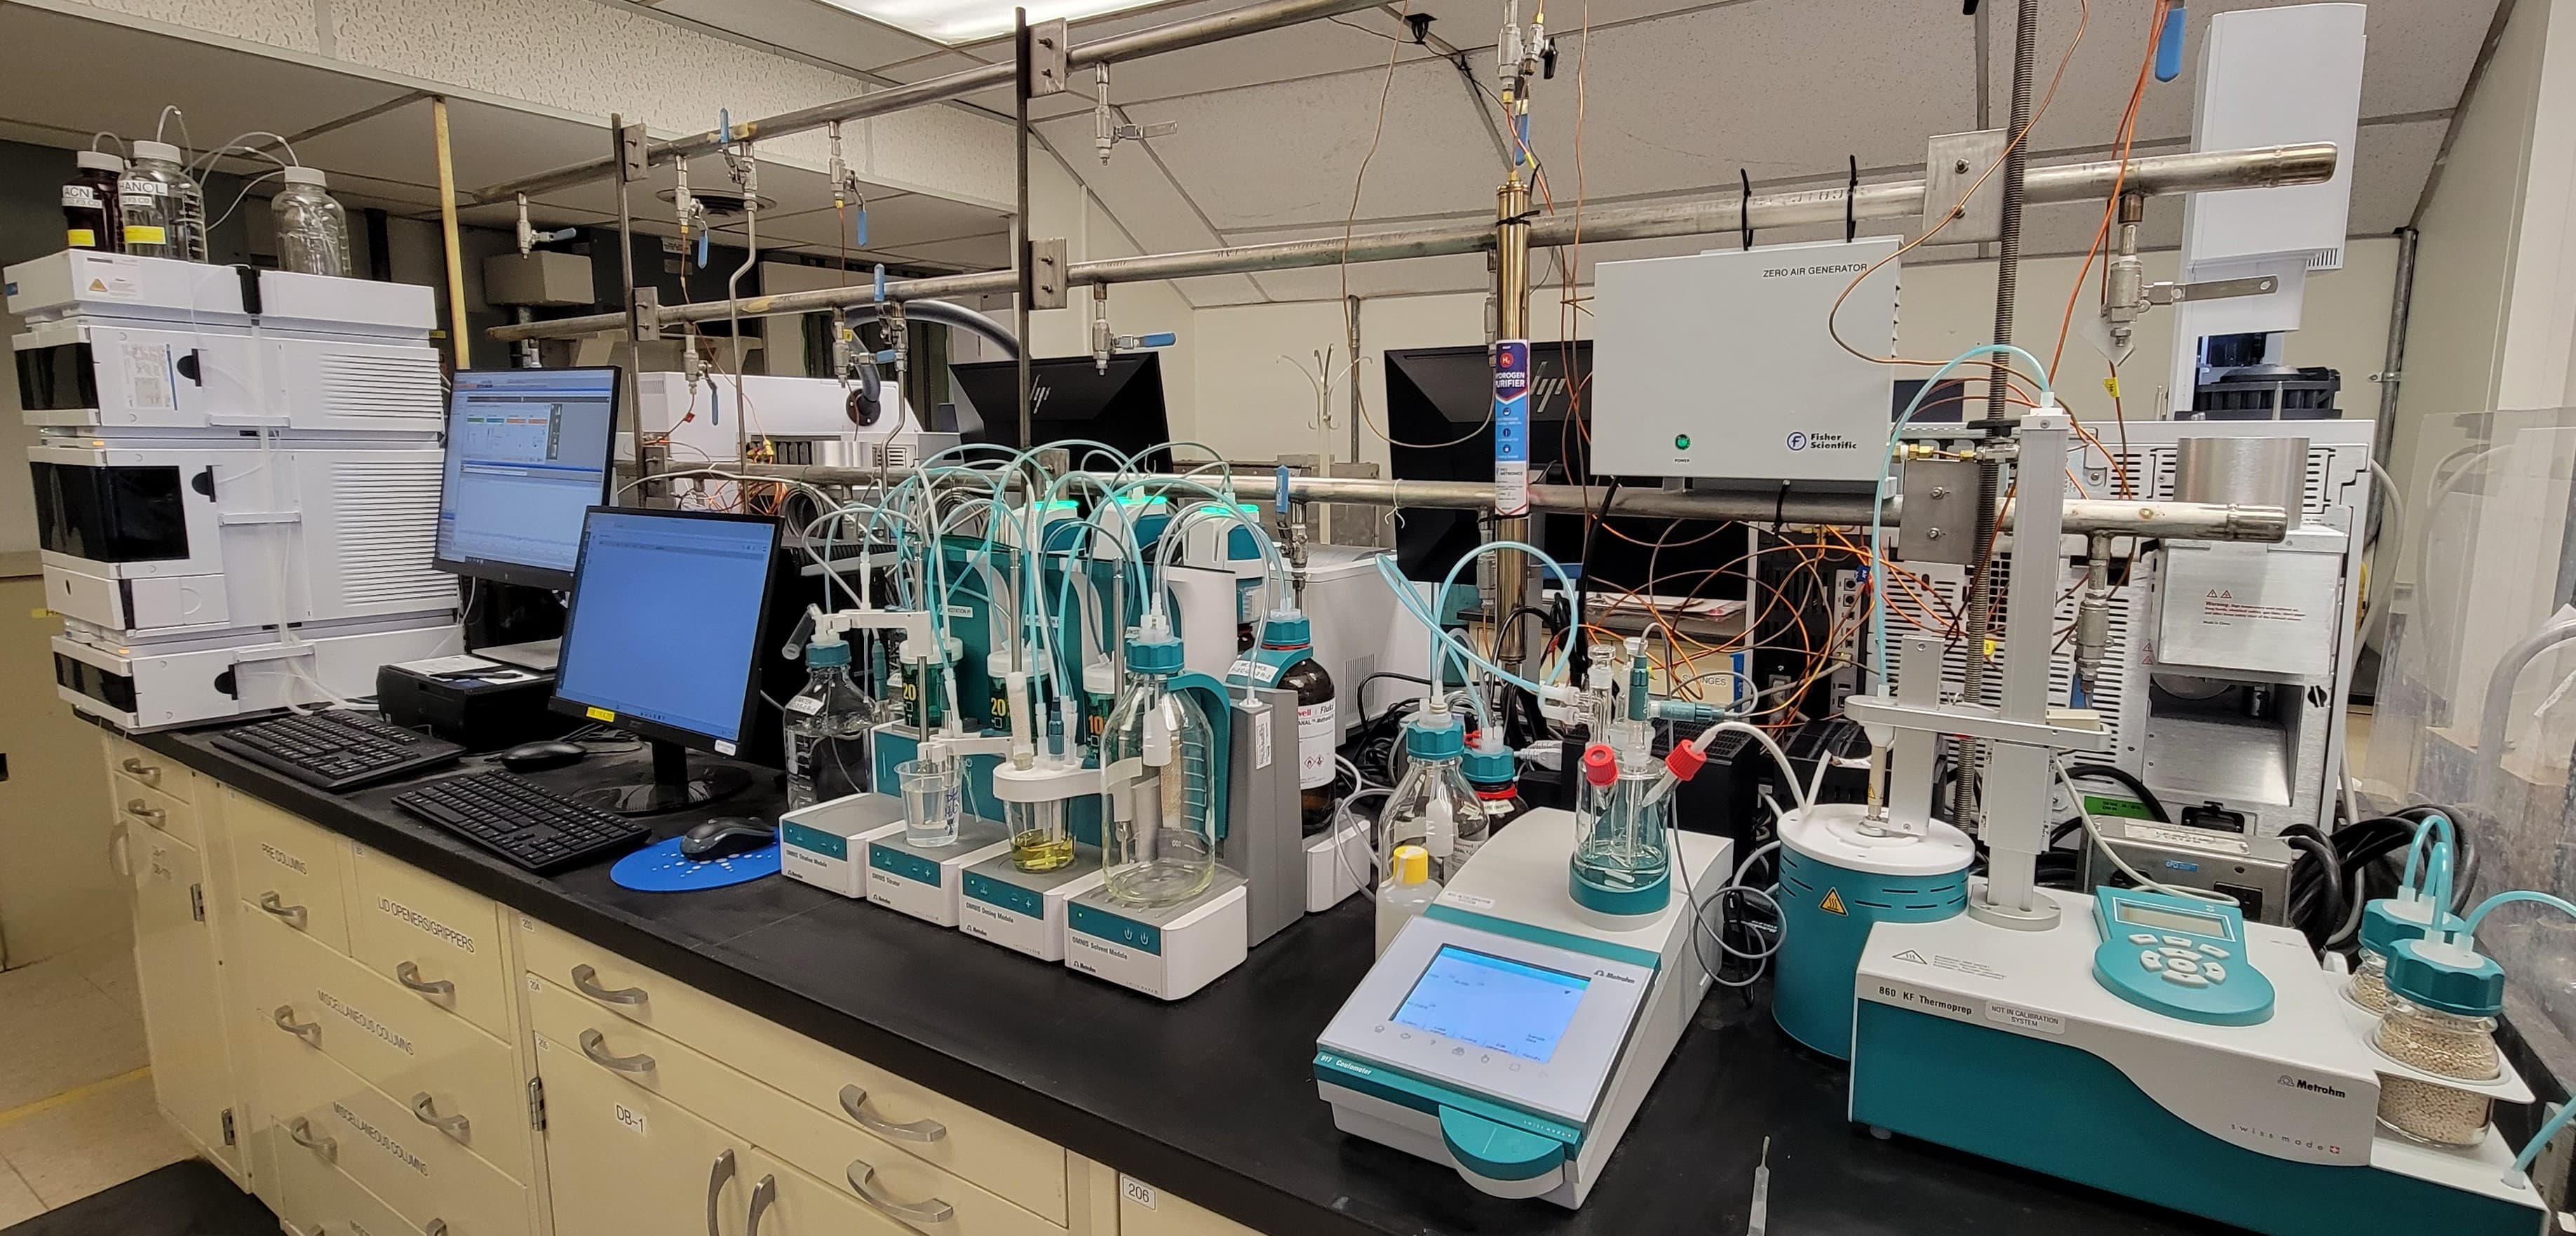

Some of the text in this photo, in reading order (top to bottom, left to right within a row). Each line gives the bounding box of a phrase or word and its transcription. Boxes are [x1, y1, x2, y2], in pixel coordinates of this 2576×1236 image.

[65, 187, 90, 199] ACN
[1763, 263, 1868, 278] ZERO AIR GENERATOR
[903, 683, 917, 701] 20
[991, 697, 1006, 716] 20
[1088, 715, 1104, 737] 10
[377, 895, 391, 913] LID
[1109, 948, 1128, 960] Module
[1879, 986, 1972, 1016] 860 KF Thermoprep
[1991, 1005, 2006, 1014] NOT
[2015, 1009, 2059, 1026] CALIBRATION
[2011, 1016, 2038, 1027] SYSTEM
[376, 1023, 414, 1056] COLUMNS
[1320, 1055, 1373, 1075] 917 Coulometer
[2296, 1079, 2345, 1099] Metrohm
[616, 1104, 643, 1133] DB-1
[2231, 1124, 2274, 1139] swiss
[1128, 1183, 1149, 1203] 206
